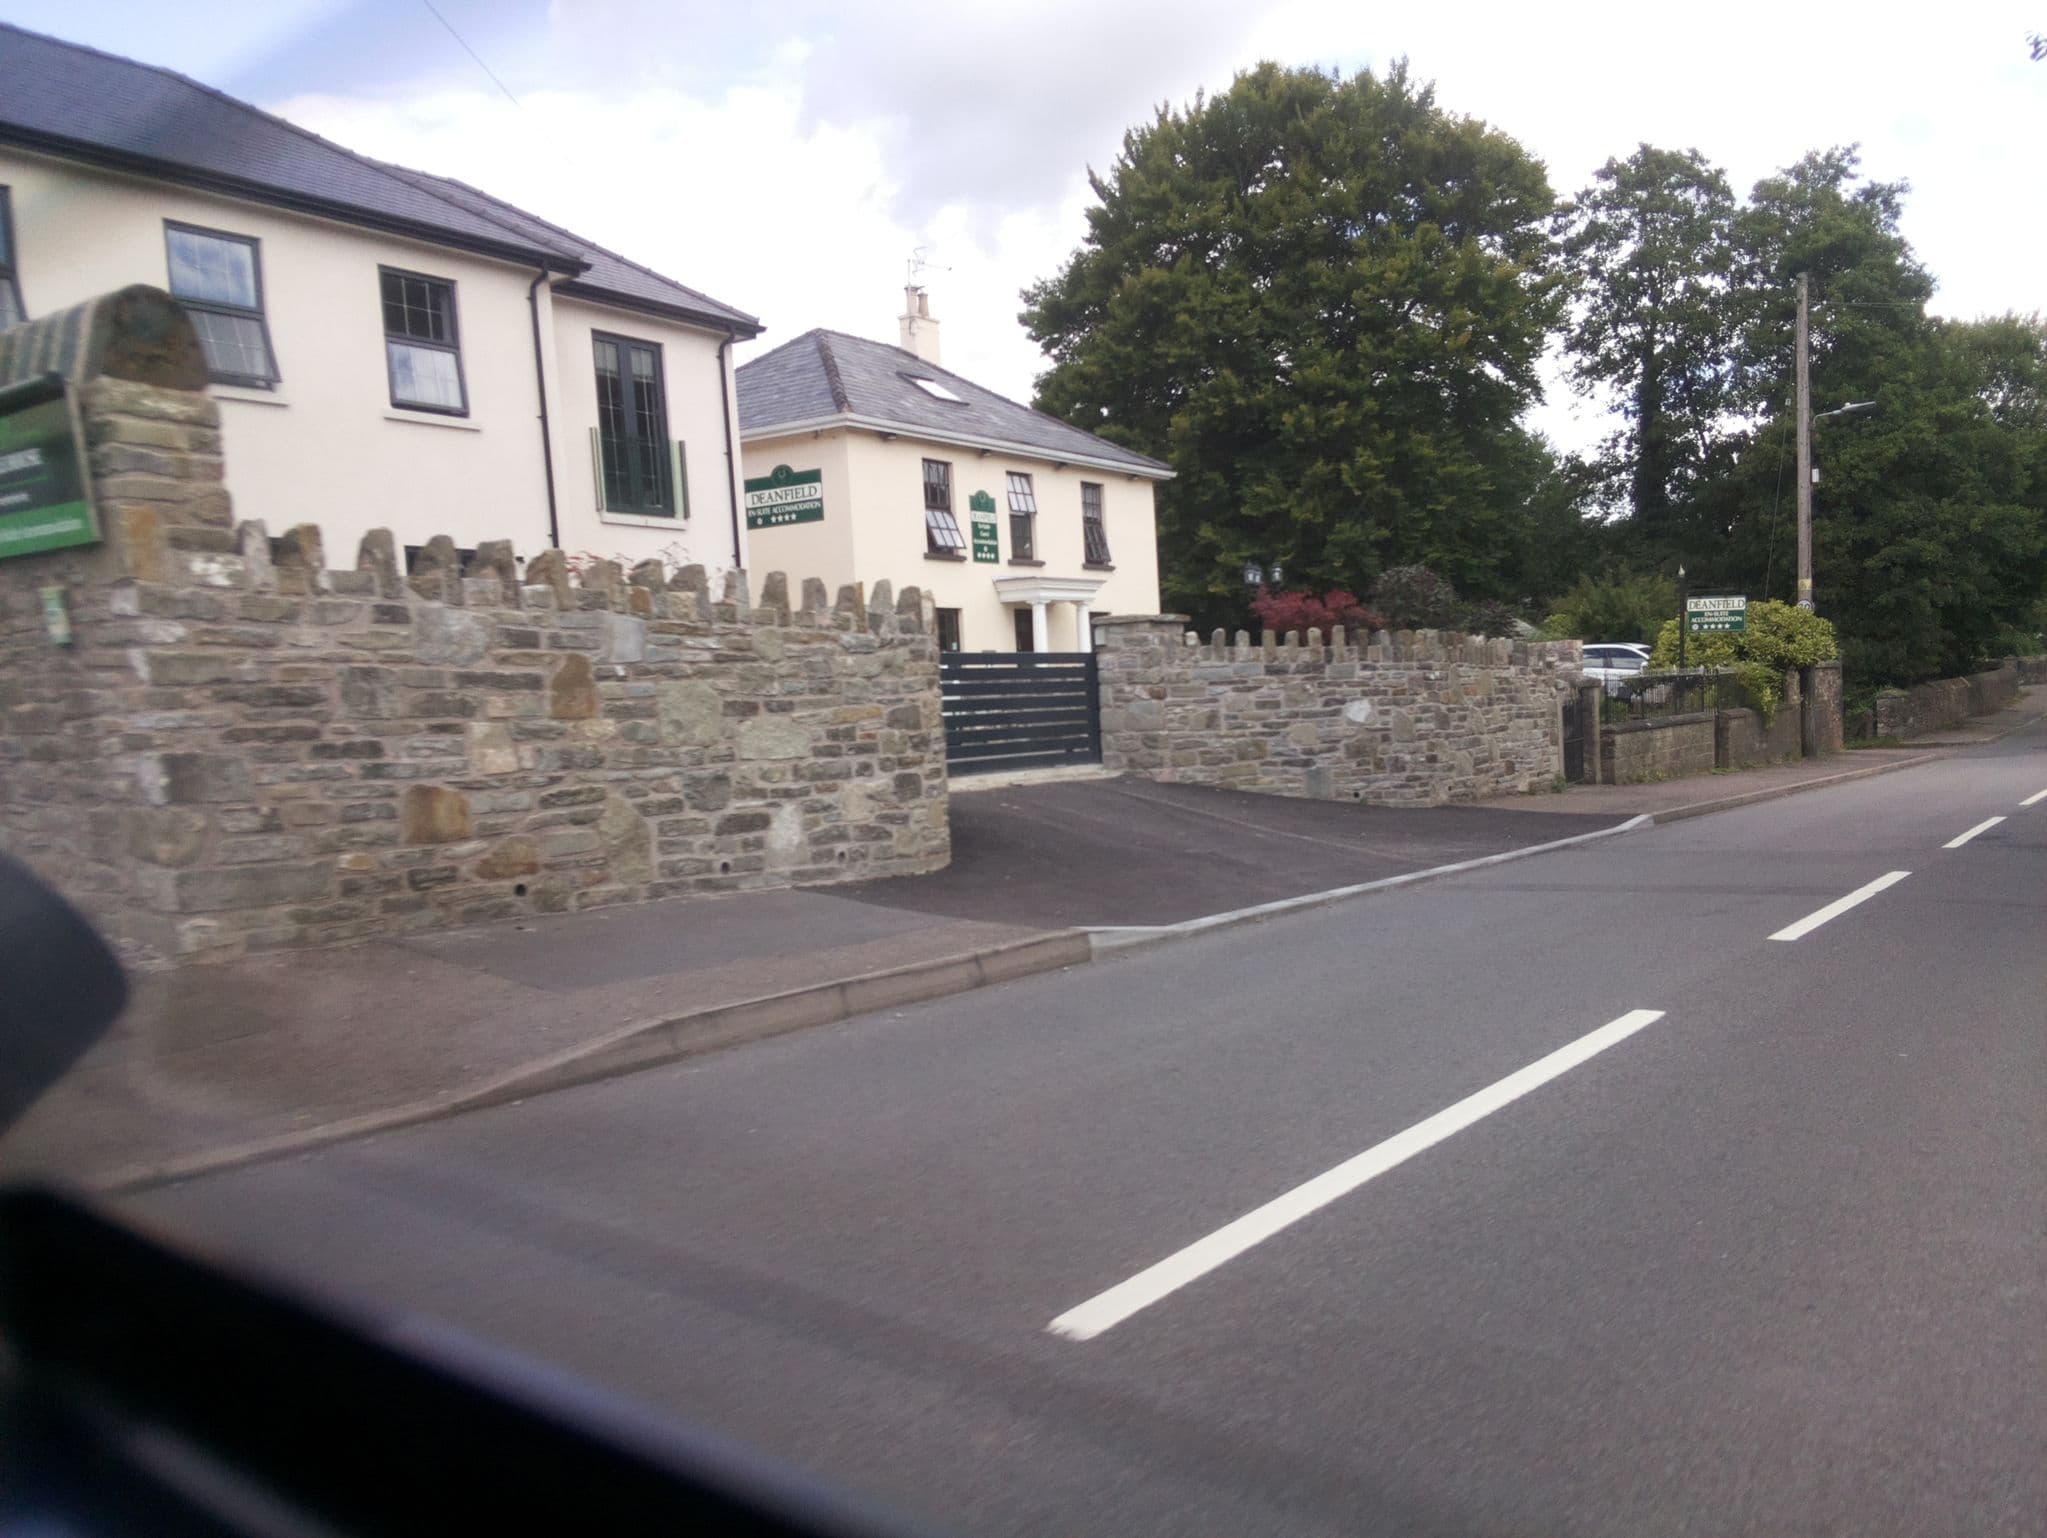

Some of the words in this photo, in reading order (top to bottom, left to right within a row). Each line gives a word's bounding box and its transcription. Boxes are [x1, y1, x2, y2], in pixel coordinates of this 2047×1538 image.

[751, 485, 818, 506] DEANFIELD
[772, 500, 821, 514] ACCOMMODATION
[1689, 599, 1745, 610] DEANFIELD
